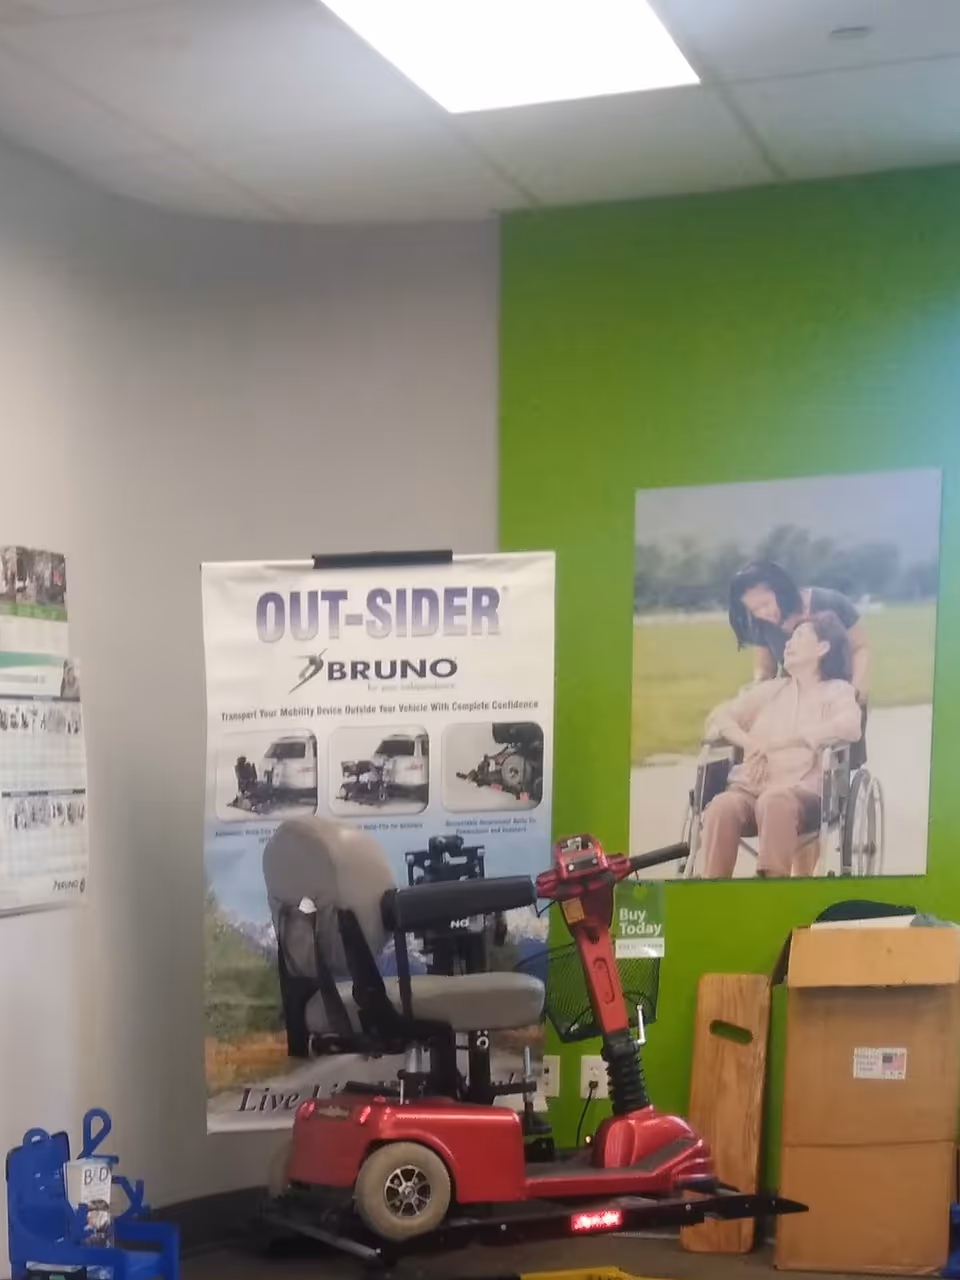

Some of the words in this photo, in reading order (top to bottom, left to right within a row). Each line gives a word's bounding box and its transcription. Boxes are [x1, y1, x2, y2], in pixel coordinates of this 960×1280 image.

[255, 585, 502, 644] OUT-SIDER
[326, 657, 458, 682] BRUNO
[280, 706, 315, 718] Mobility
[317, 705, 342, 716] Device
[344, 704, 376, 715] Outside
[398, 702, 428, 714] Vehicle
[430, 701, 450, 712] With
[451, 700, 489, 713] Complete
[491, 699, 539, 711] Confidence
[618, 908, 646, 923] Buy
[618, 921, 662, 937] Today
[237, 1086, 301, 1113] Live
